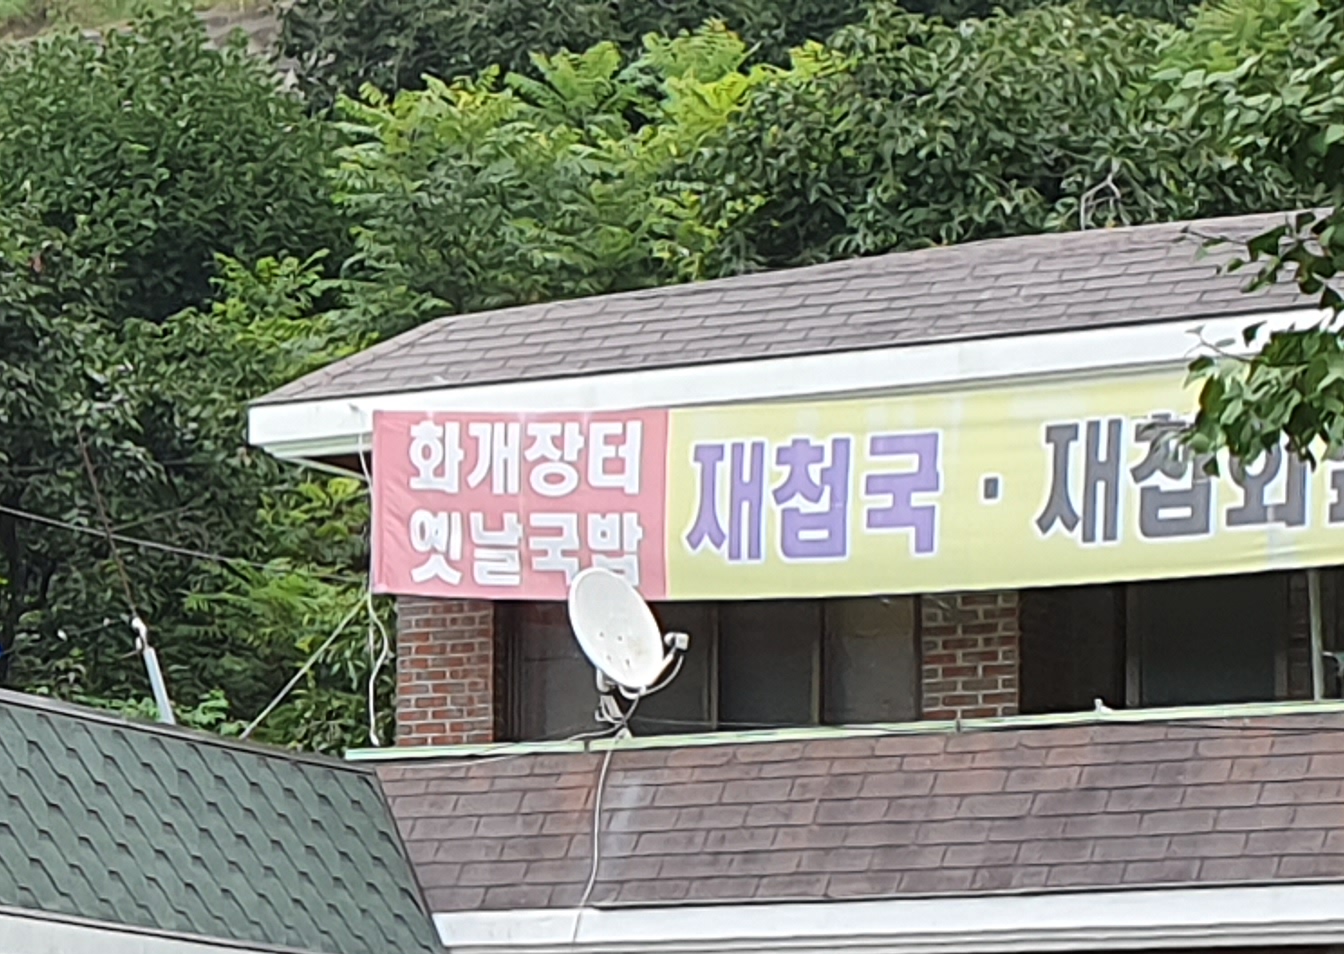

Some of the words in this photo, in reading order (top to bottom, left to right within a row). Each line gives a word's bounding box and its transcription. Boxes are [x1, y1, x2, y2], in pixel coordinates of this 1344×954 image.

[409, 420, 643, 497] 화개장터
[685, 432, 940, 562] 재첩국
[409, 509, 644, 587] 옛날국밥
